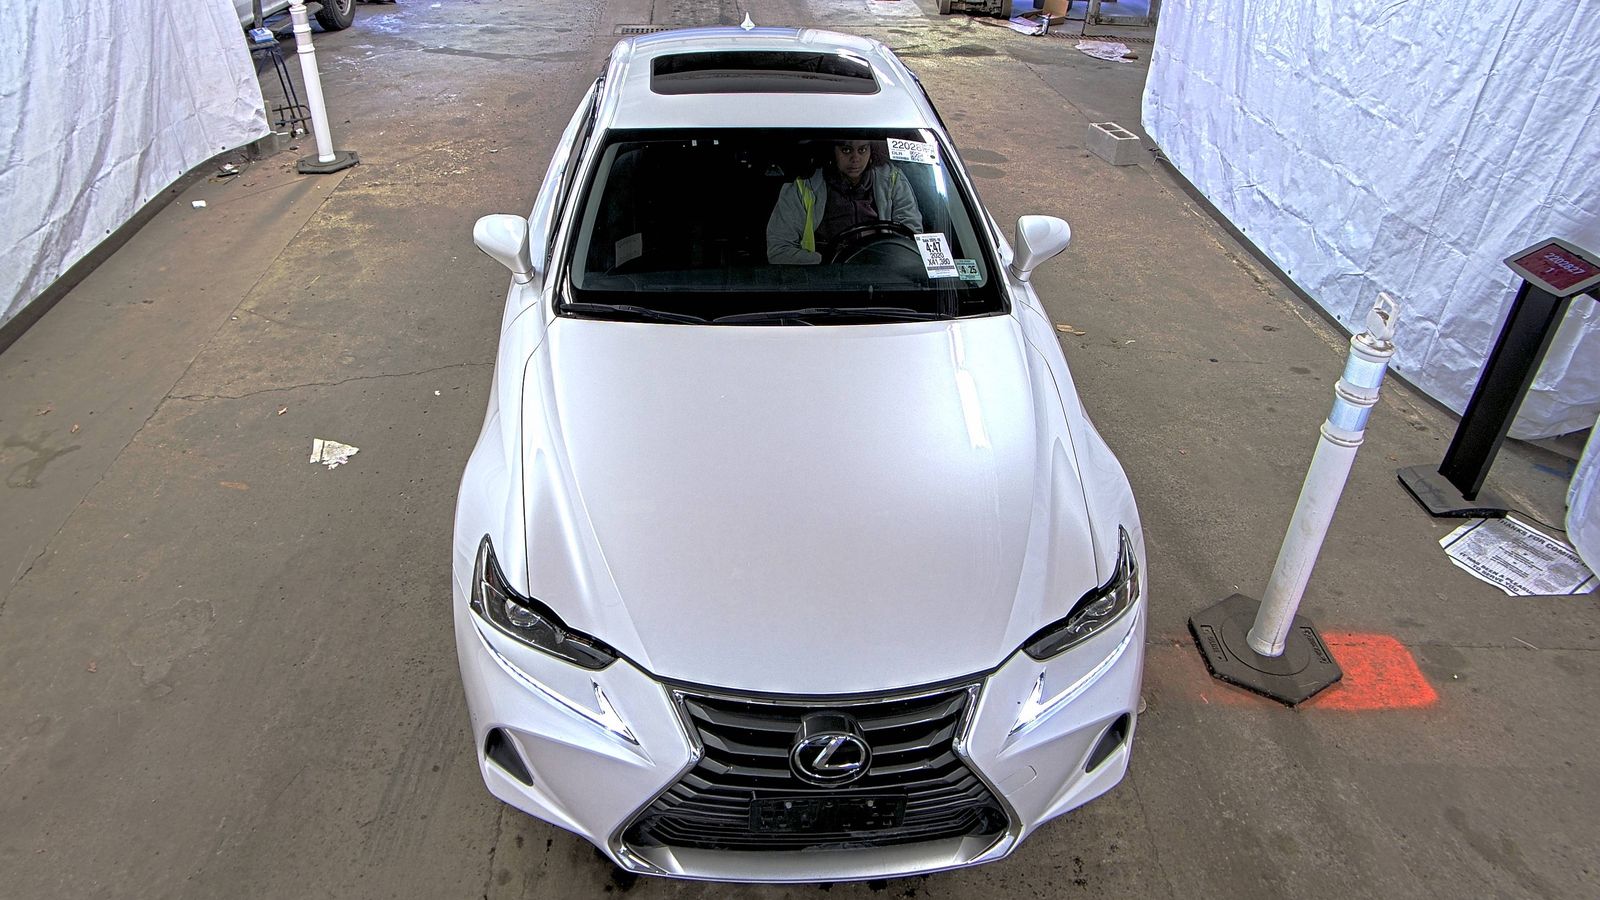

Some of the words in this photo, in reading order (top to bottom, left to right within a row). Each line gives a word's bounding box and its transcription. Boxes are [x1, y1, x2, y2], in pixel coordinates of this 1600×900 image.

[925, 241, 942, 253] 4:47
[1544, 252, 1586, 275] 2202827
[1527, 533, 1546, 545] FOR
[1545, 542, 1580, 564] COMING
[1480, 565, 1499, 576] BEEN
[1505, 577, 1537, 596] PLEASUR
[1504, 581, 1520, 592] YOU
